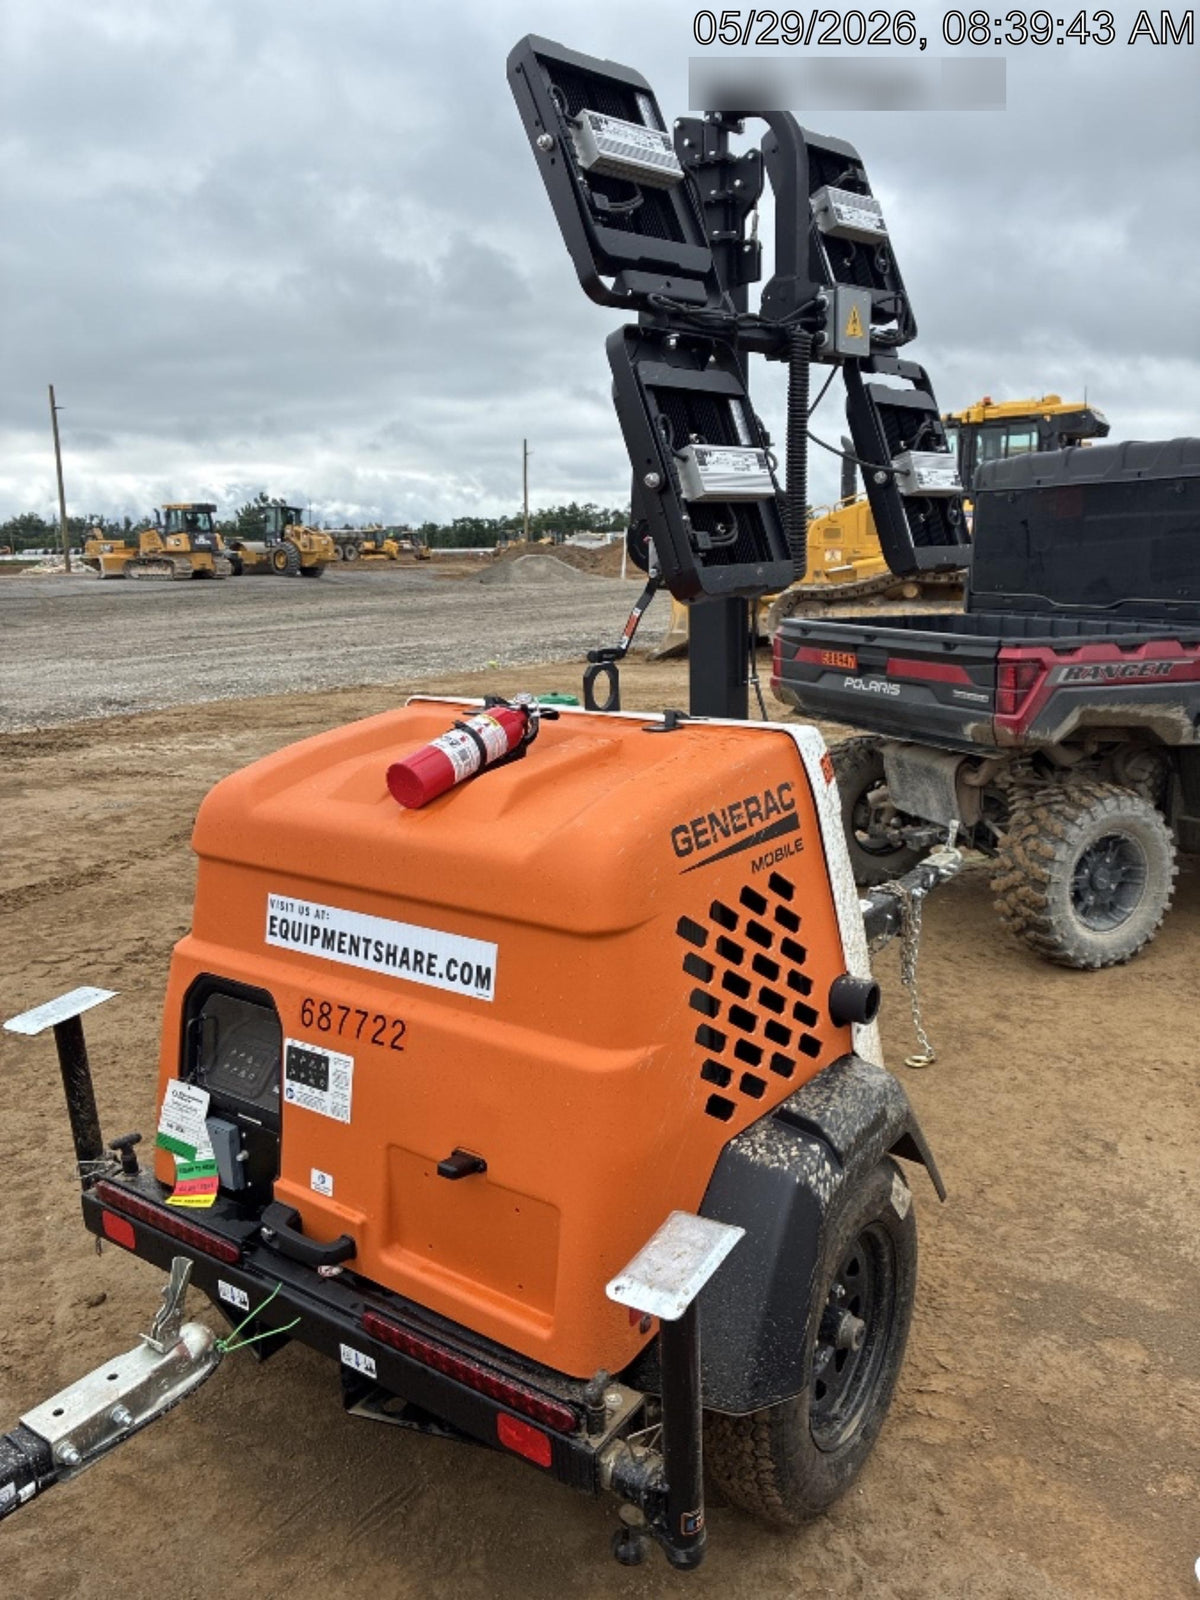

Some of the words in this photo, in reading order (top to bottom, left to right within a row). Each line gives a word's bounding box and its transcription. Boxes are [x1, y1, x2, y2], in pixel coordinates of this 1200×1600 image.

[844, 676, 900, 696] POLARIS
[1064, 661, 1173, 681] RANGER
[671, 782, 796, 858] GENERAC
[751, 838, 804, 874] MOBILE
[269, 898, 294, 912] VISIT
[298, 905, 310, 917] US
[314, 909, 330, 920] AT:
[268, 915, 492, 991] EQUIPMENTSHARE.COM
[301, 998, 406, 1051] 687722
